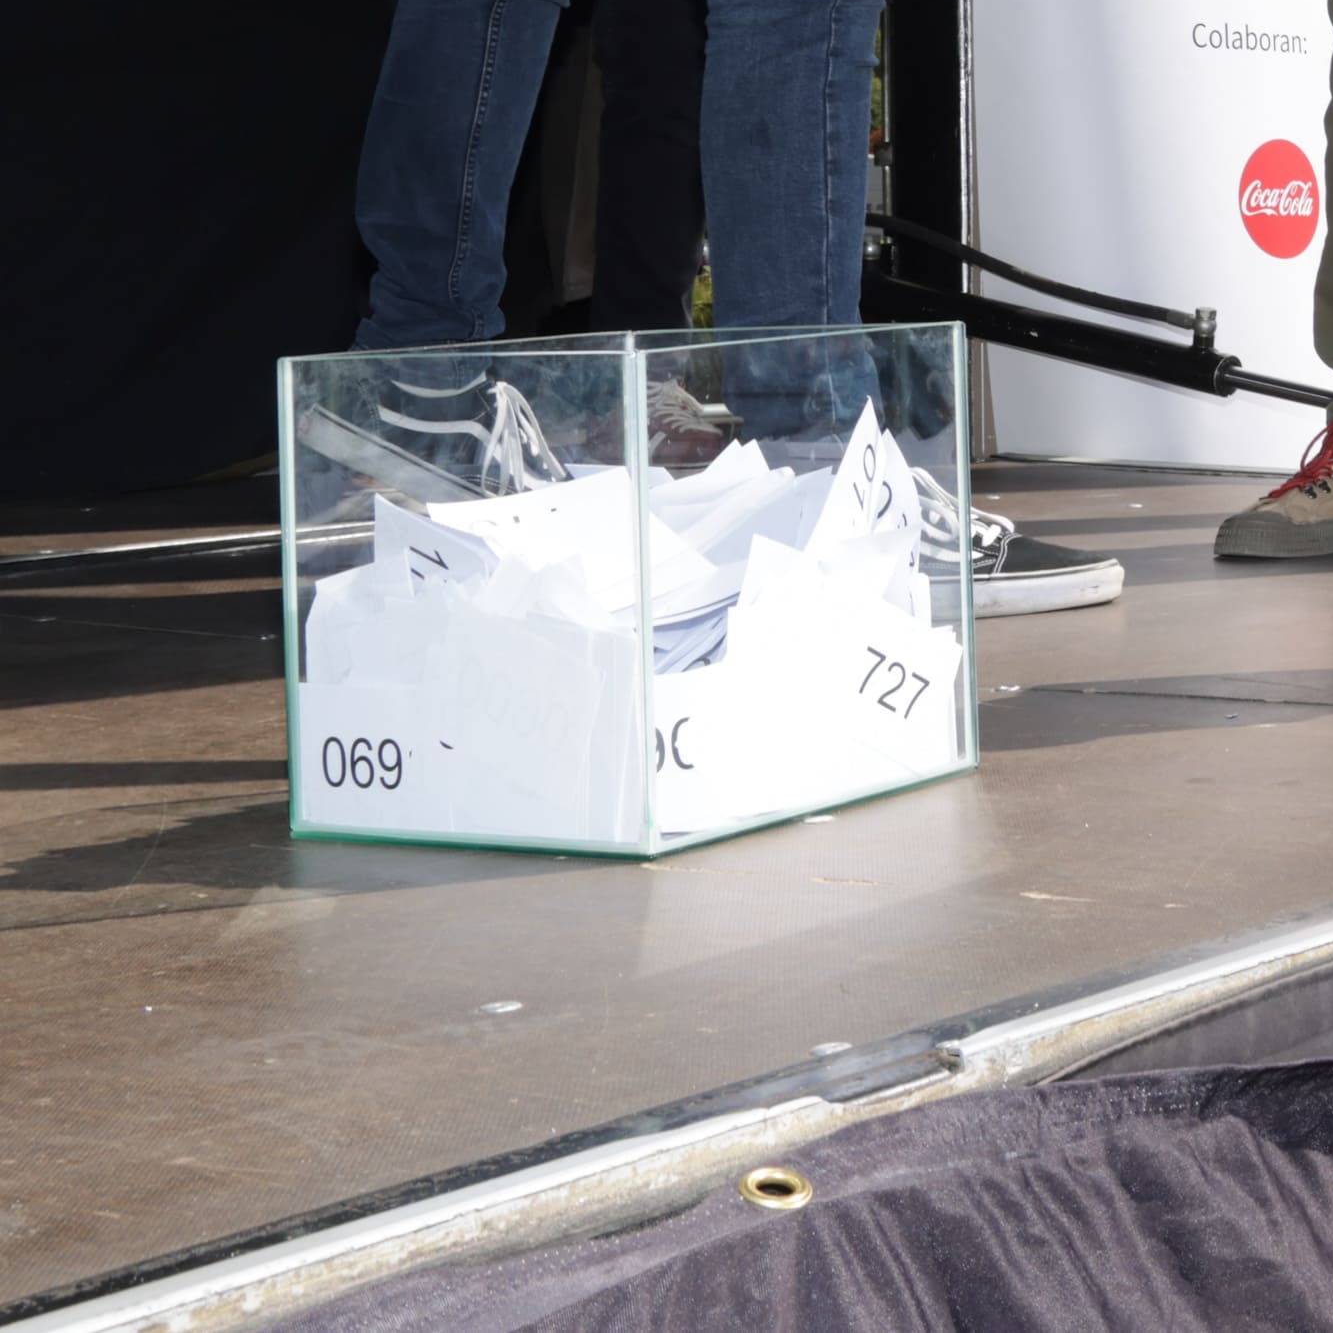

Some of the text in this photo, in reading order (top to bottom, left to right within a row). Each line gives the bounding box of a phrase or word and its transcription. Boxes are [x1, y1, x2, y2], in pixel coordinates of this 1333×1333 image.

[1191, 22, 1308, 55] Colaboran:
[858, 646, 930, 720] 727
[322, 735, 403, 791] 069
